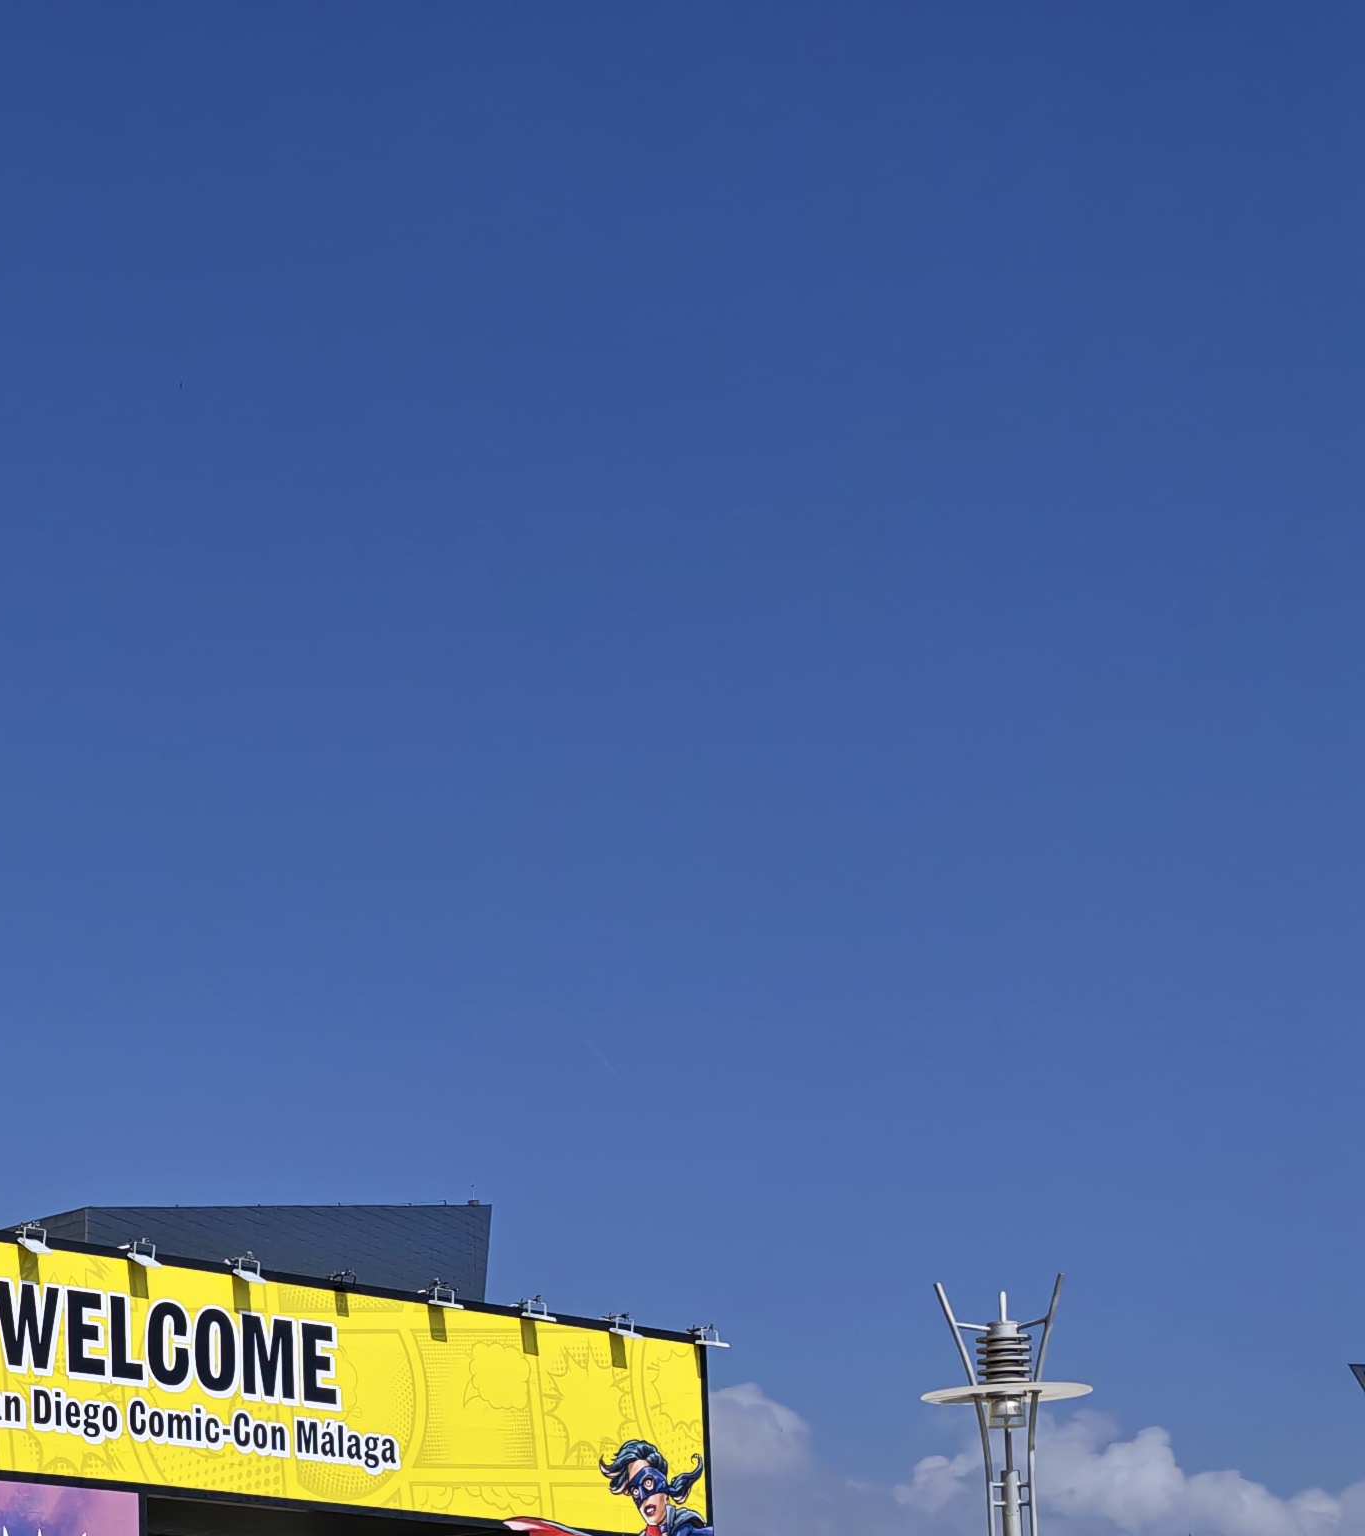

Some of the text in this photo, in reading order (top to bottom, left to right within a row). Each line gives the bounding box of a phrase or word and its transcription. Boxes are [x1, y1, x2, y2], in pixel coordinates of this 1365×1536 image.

[32, 1389, 119, 1439] Diego
[128, 1400, 286, 1452] Comic-Con
[296, 1420, 398, 1468] Málaga
